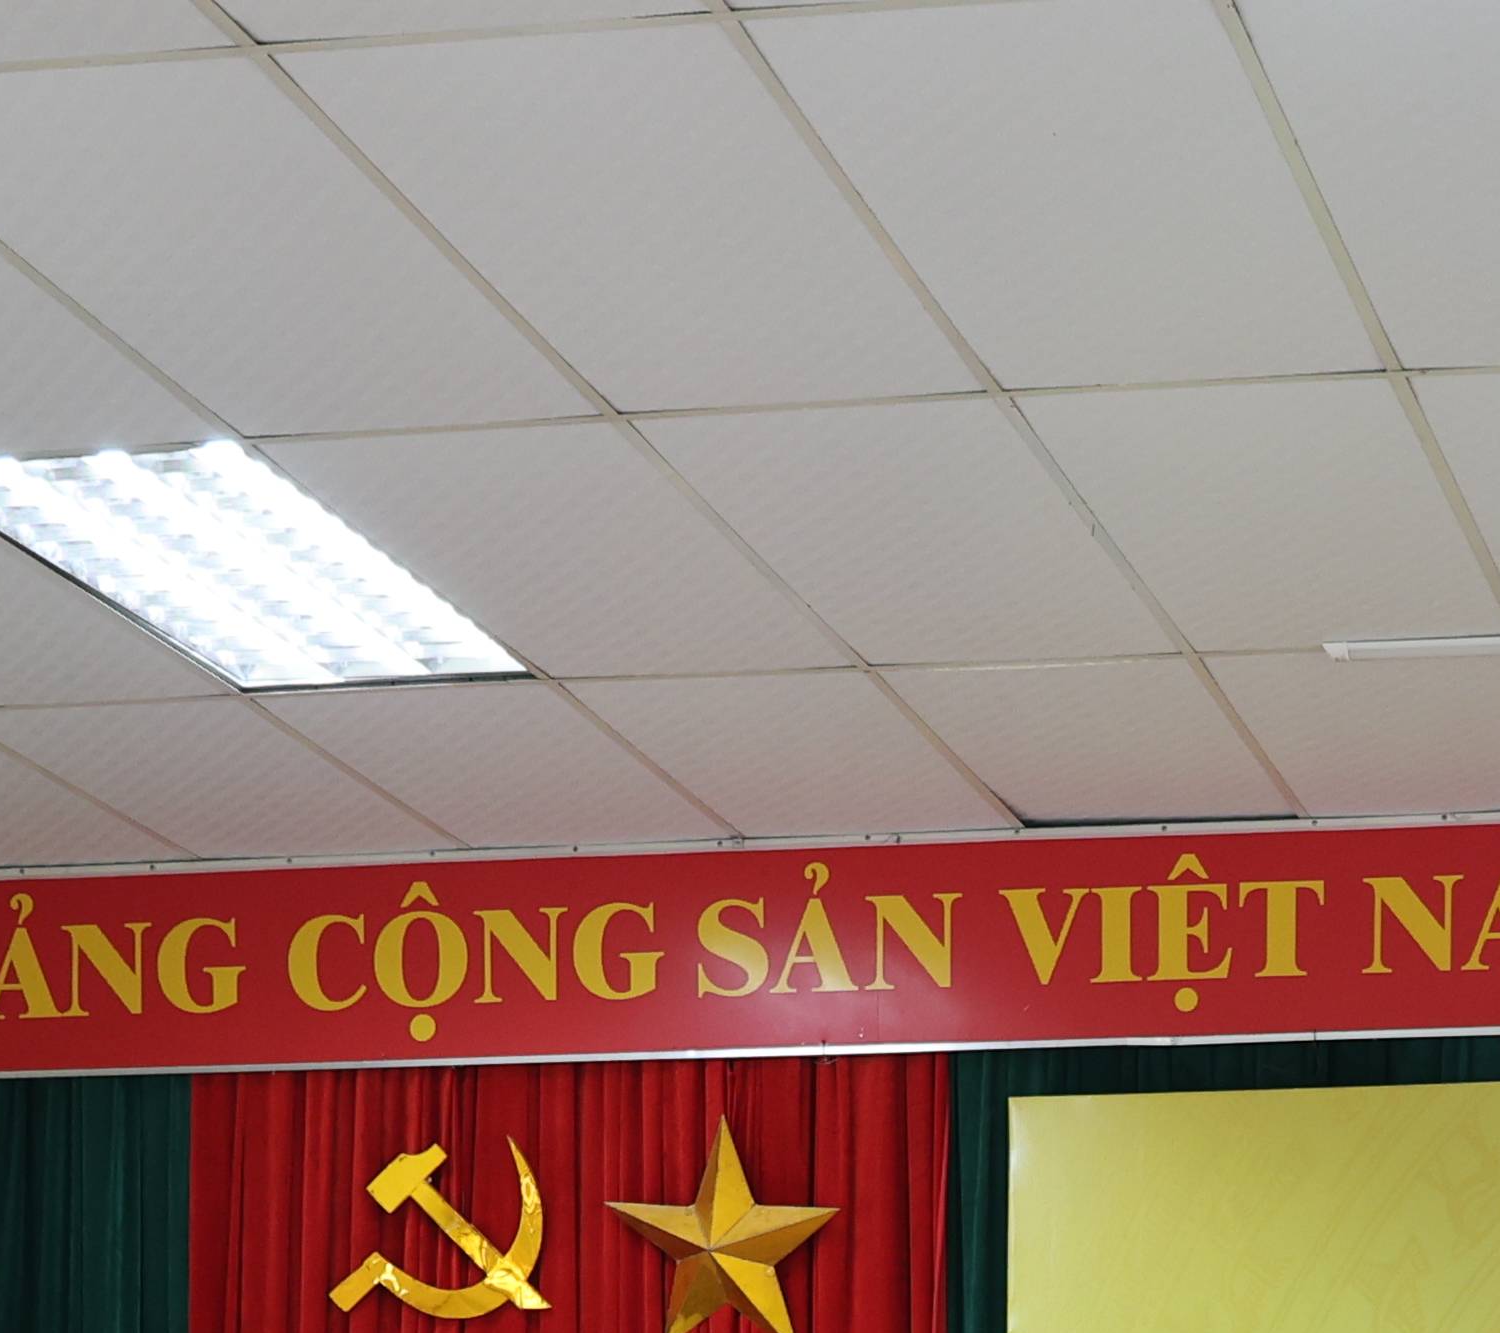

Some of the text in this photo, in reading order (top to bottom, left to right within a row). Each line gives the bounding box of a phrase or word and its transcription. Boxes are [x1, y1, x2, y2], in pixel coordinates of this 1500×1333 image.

[287, 880, 665, 1042] CỘNG
[697, 862, 963, 996] SẢN
[1000, 853, 1326, 1012] VIỆT
